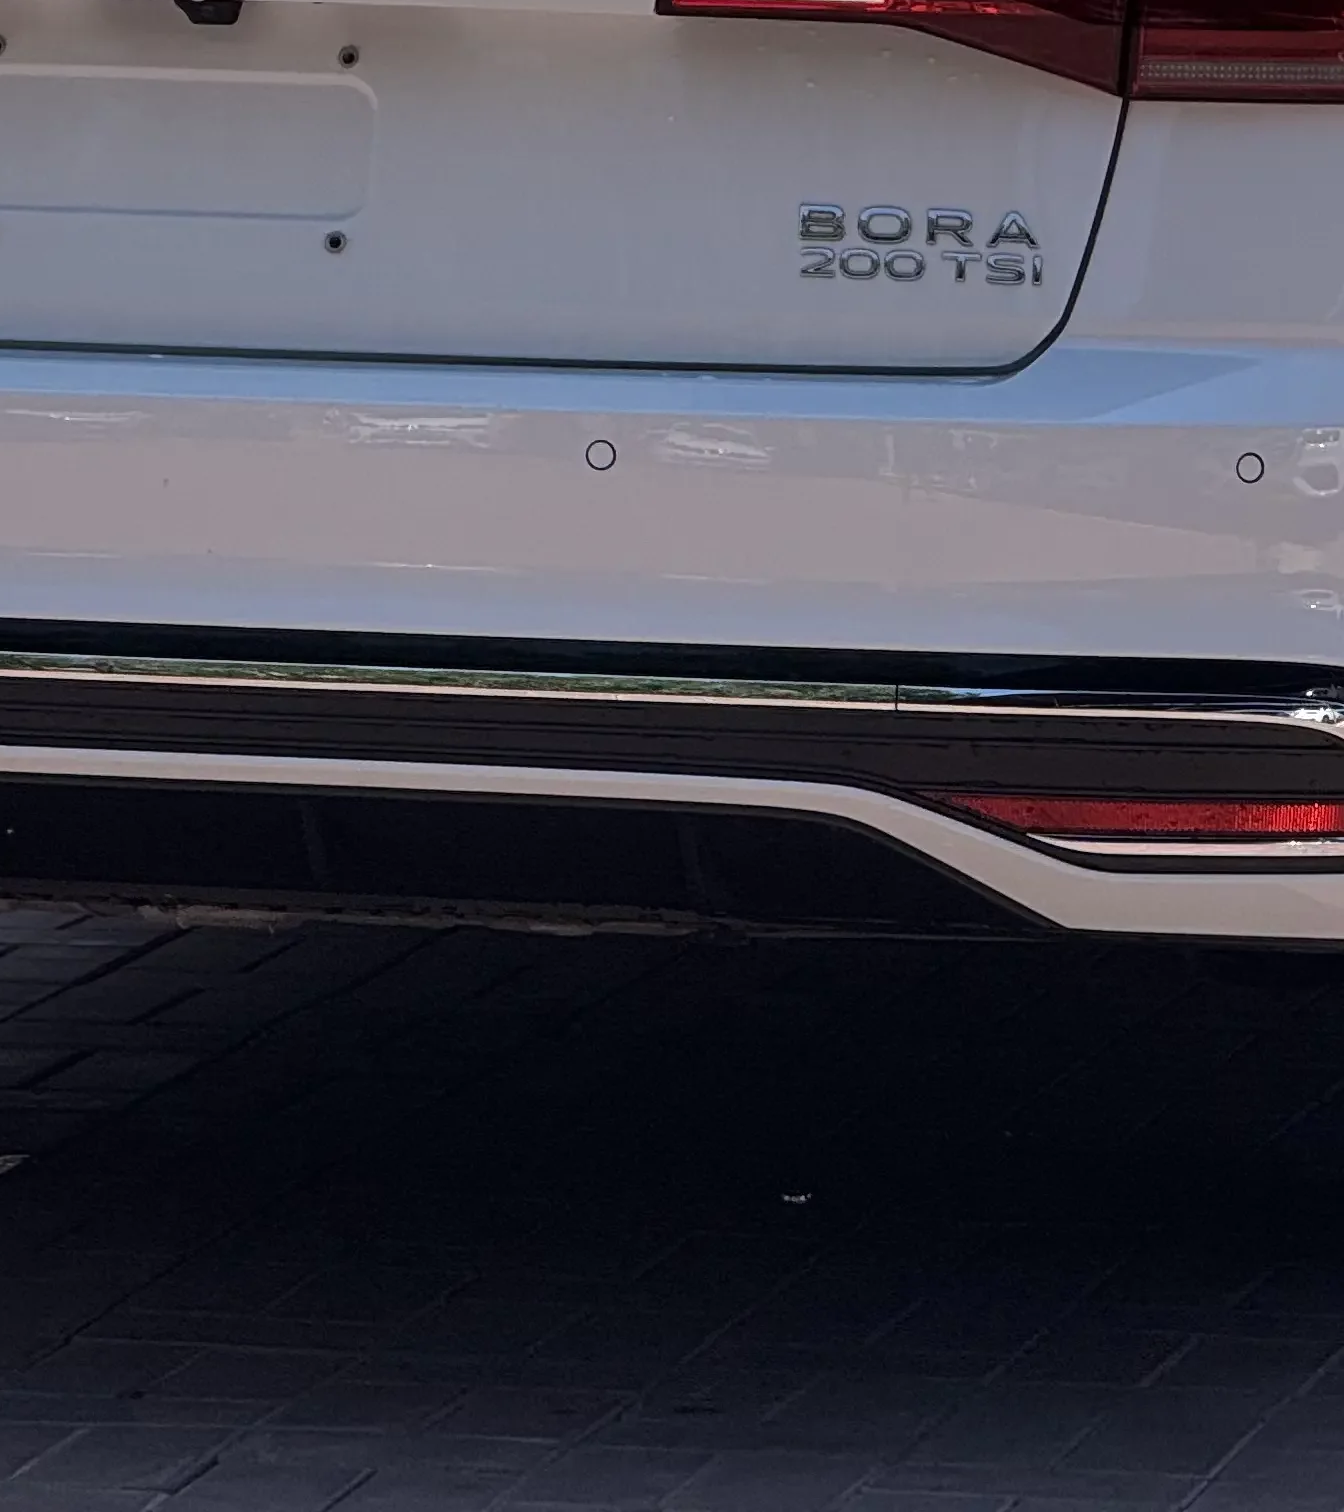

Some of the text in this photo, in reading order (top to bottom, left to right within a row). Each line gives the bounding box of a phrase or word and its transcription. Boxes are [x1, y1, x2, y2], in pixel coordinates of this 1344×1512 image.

[798, 202, 1040, 249] BORA
[799, 247, 1044, 286] 200 TSI
